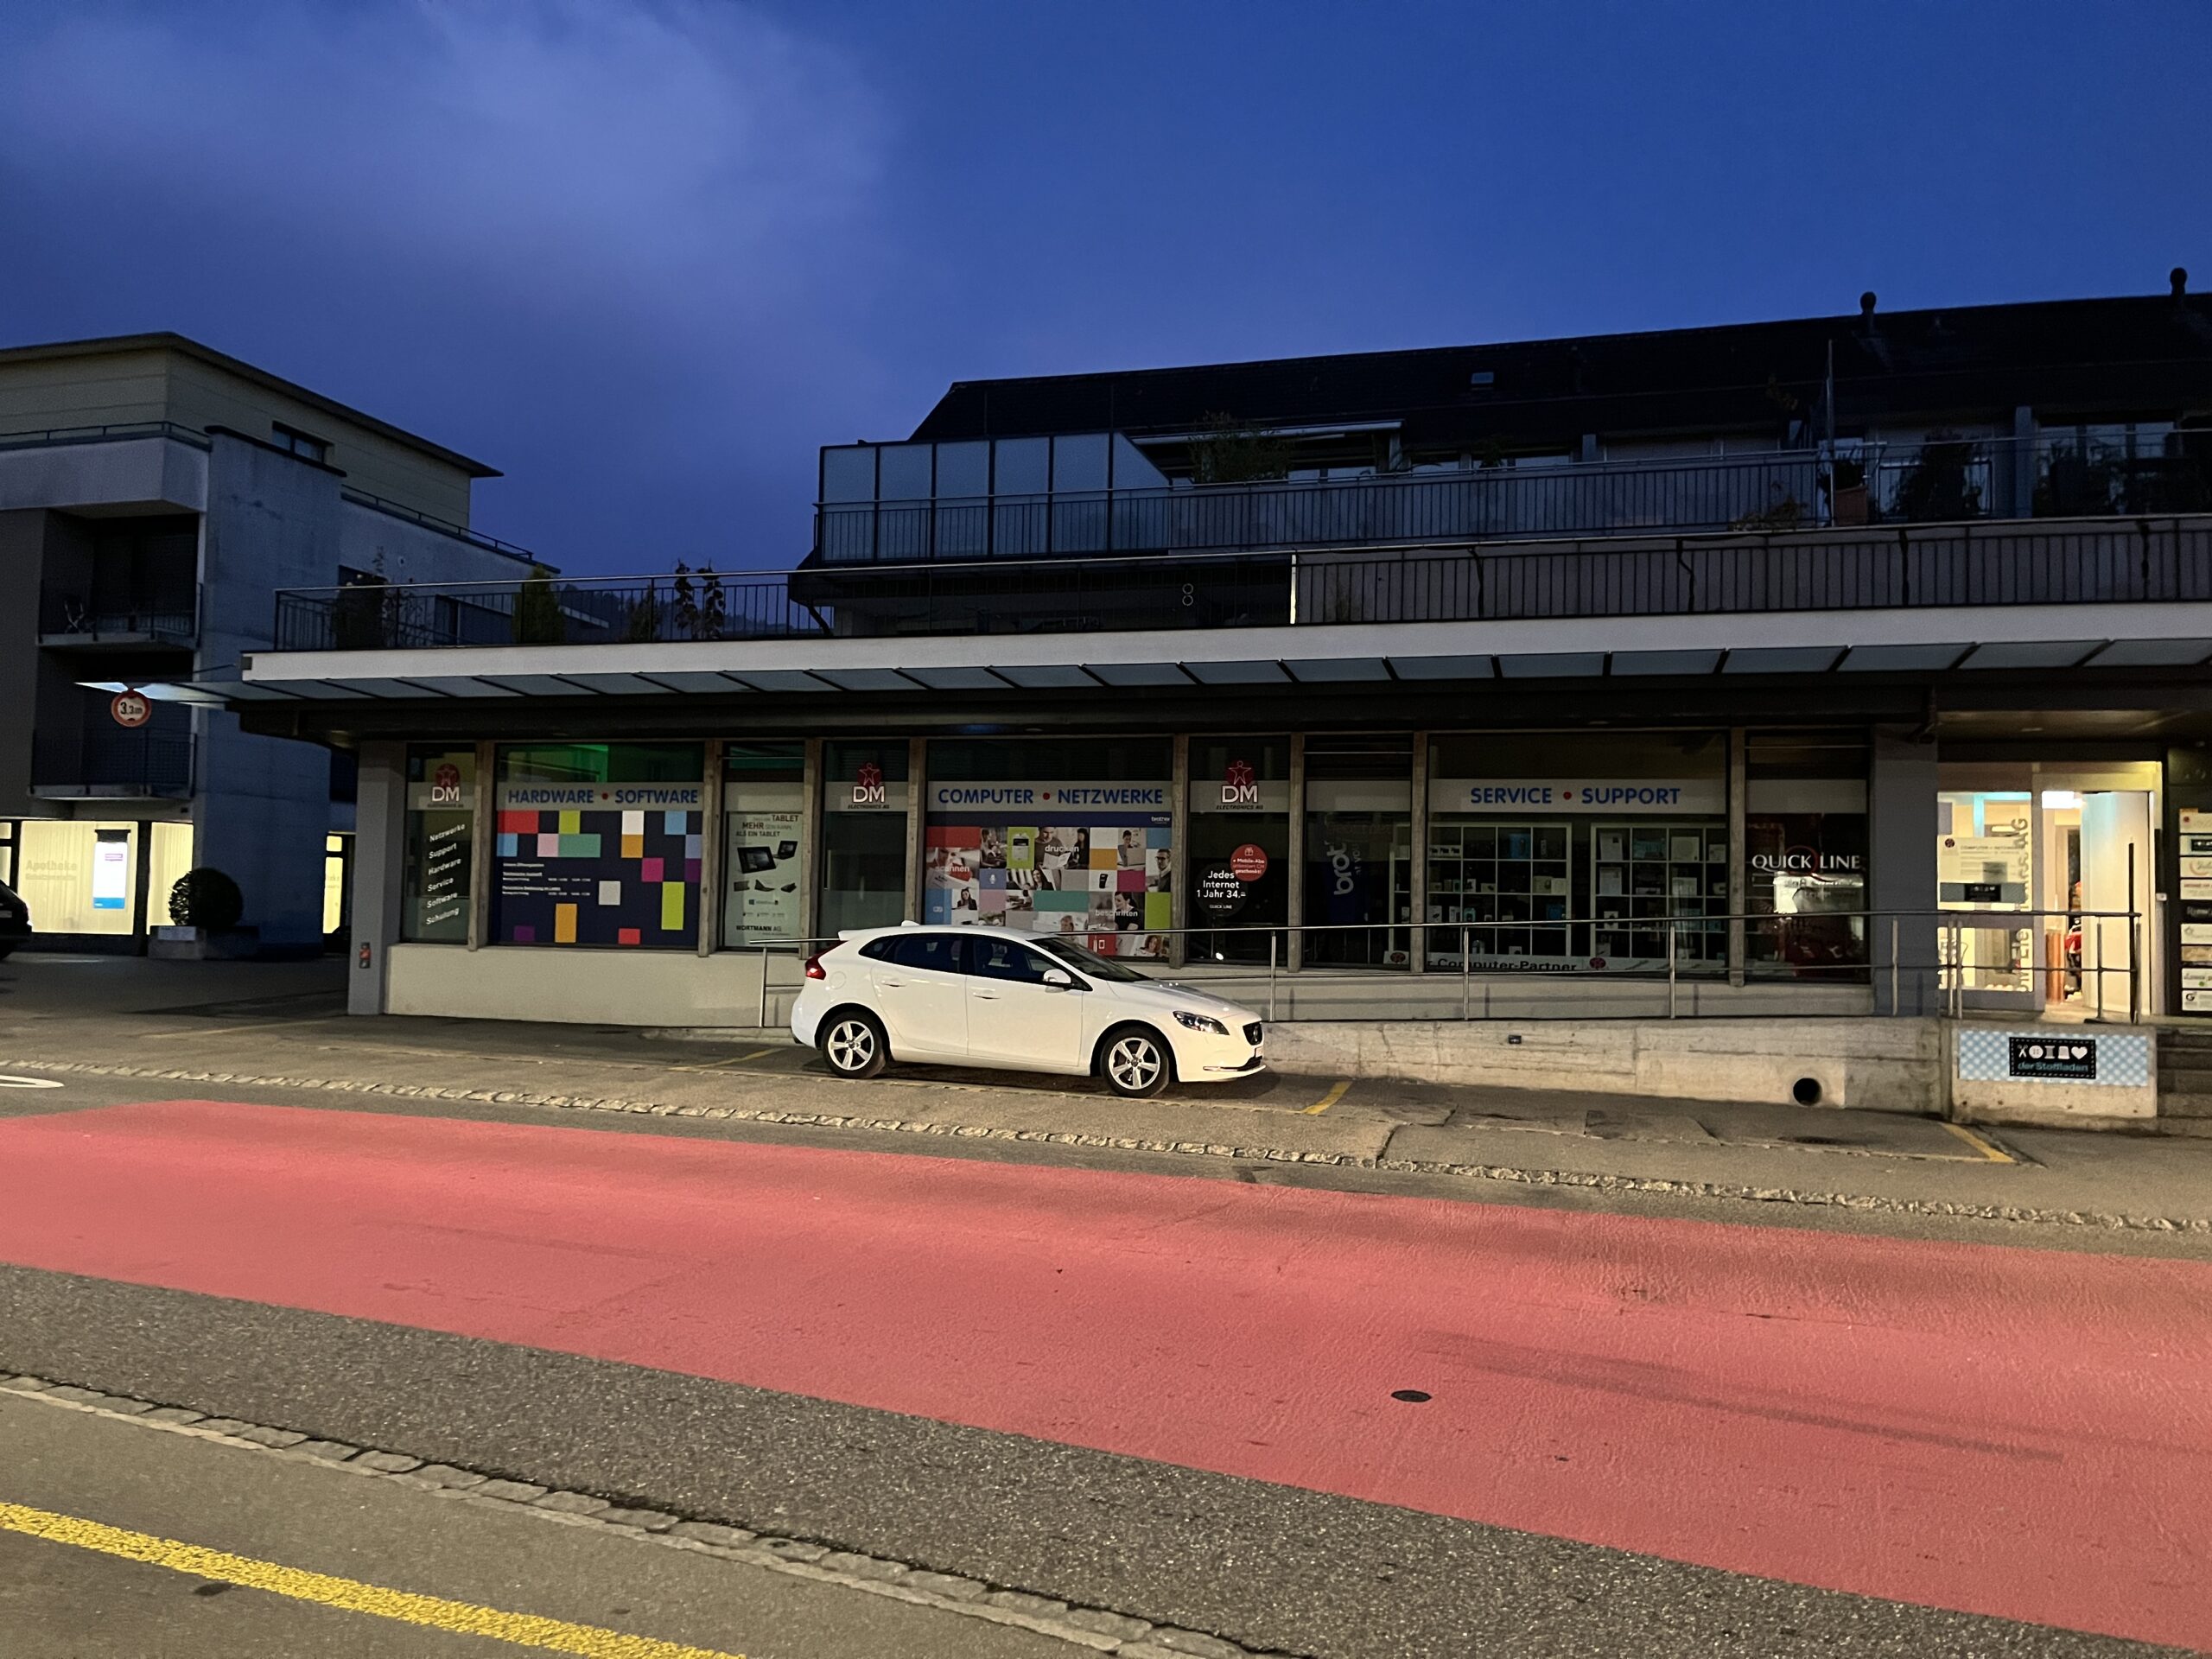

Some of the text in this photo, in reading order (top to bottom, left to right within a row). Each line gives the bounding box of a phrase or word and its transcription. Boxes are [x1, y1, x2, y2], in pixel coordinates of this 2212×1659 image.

[432, 786, 460, 802] DM
[508, 789, 698, 804] HARDWARE SOFTWARE
[853, 785, 885, 803] DM
[939, 788, 1163, 804] COMPUTER NETZWERKE
[1222, 785, 1258, 803] DM
[1471, 787, 1681, 804] SERVICE SUPPORT
[429, 823, 466, 842] Netzwerke
[429, 842, 457, 859] Support
[428, 858, 461, 875] Hardware
[1326, 840, 1355, 895] brot
[1751, 854, 1859, 872] QUICK LINE
[1207, 869, 1235, 879] Jedes
[427, 877, 454, 892] Service
[1203, 880, 1240, 889] Internet
[427, 892, 458, 908] Software
[1203, 889, 1224, 898] Jahr
[426, 907, 460, 925] Schulung
